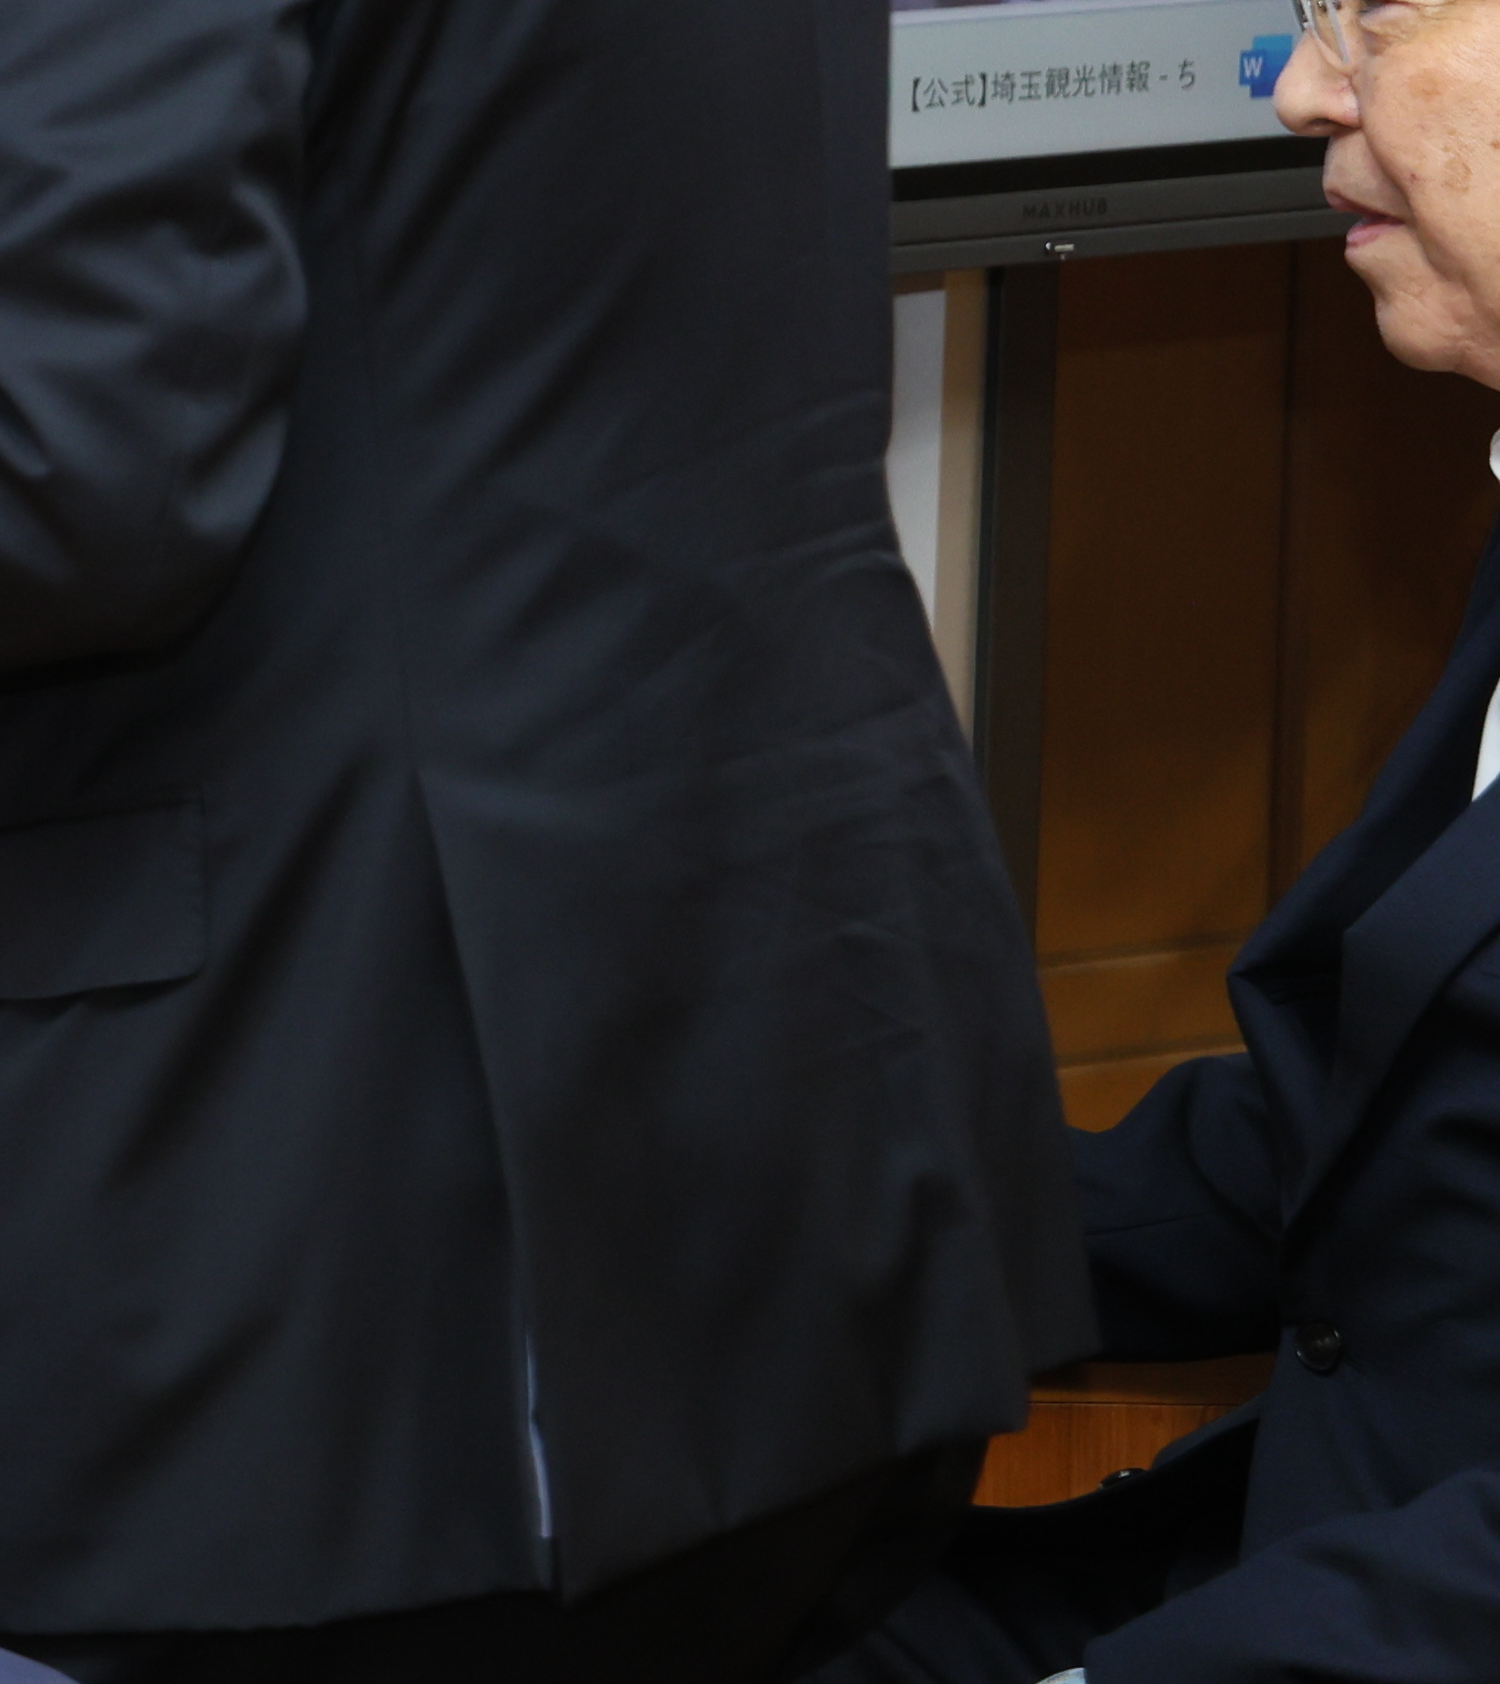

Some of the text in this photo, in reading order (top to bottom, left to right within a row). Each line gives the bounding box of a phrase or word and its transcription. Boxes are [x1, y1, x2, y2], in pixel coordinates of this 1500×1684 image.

[1243, 56, 1264, 78] W
[912, 61, 1151, 112] 【公式】埼玉観光情報
[1022, 196, 1108, 220] MAXHUB
